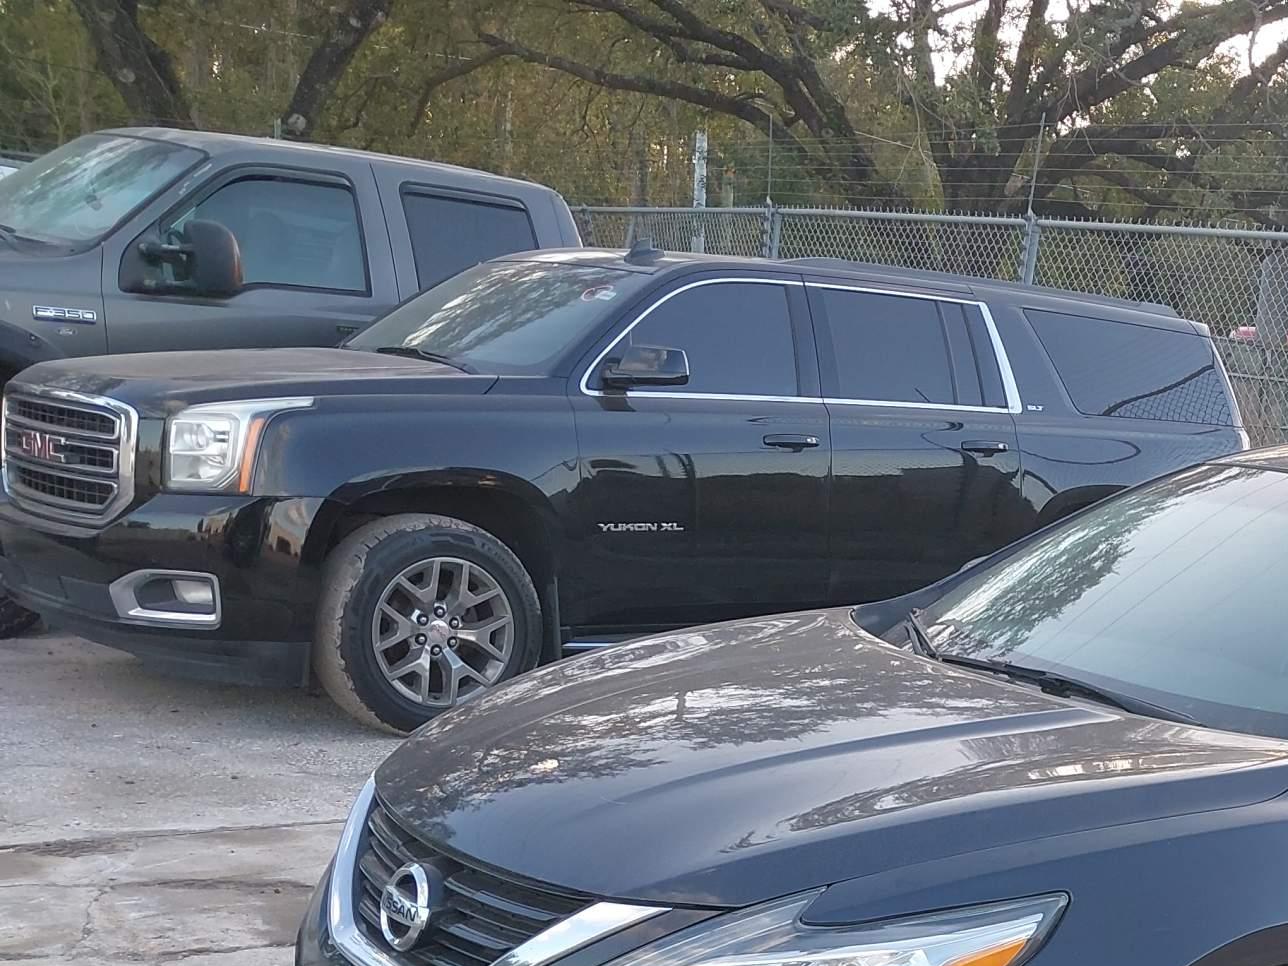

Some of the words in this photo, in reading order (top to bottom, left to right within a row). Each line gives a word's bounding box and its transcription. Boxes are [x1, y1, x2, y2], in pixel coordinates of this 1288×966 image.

[21, 429, 66, 463] GMC
[597, 523, 657, 531] YUKON
[660, 523, 684, 531] XL
[384, 895, 418, 922] SSAN
